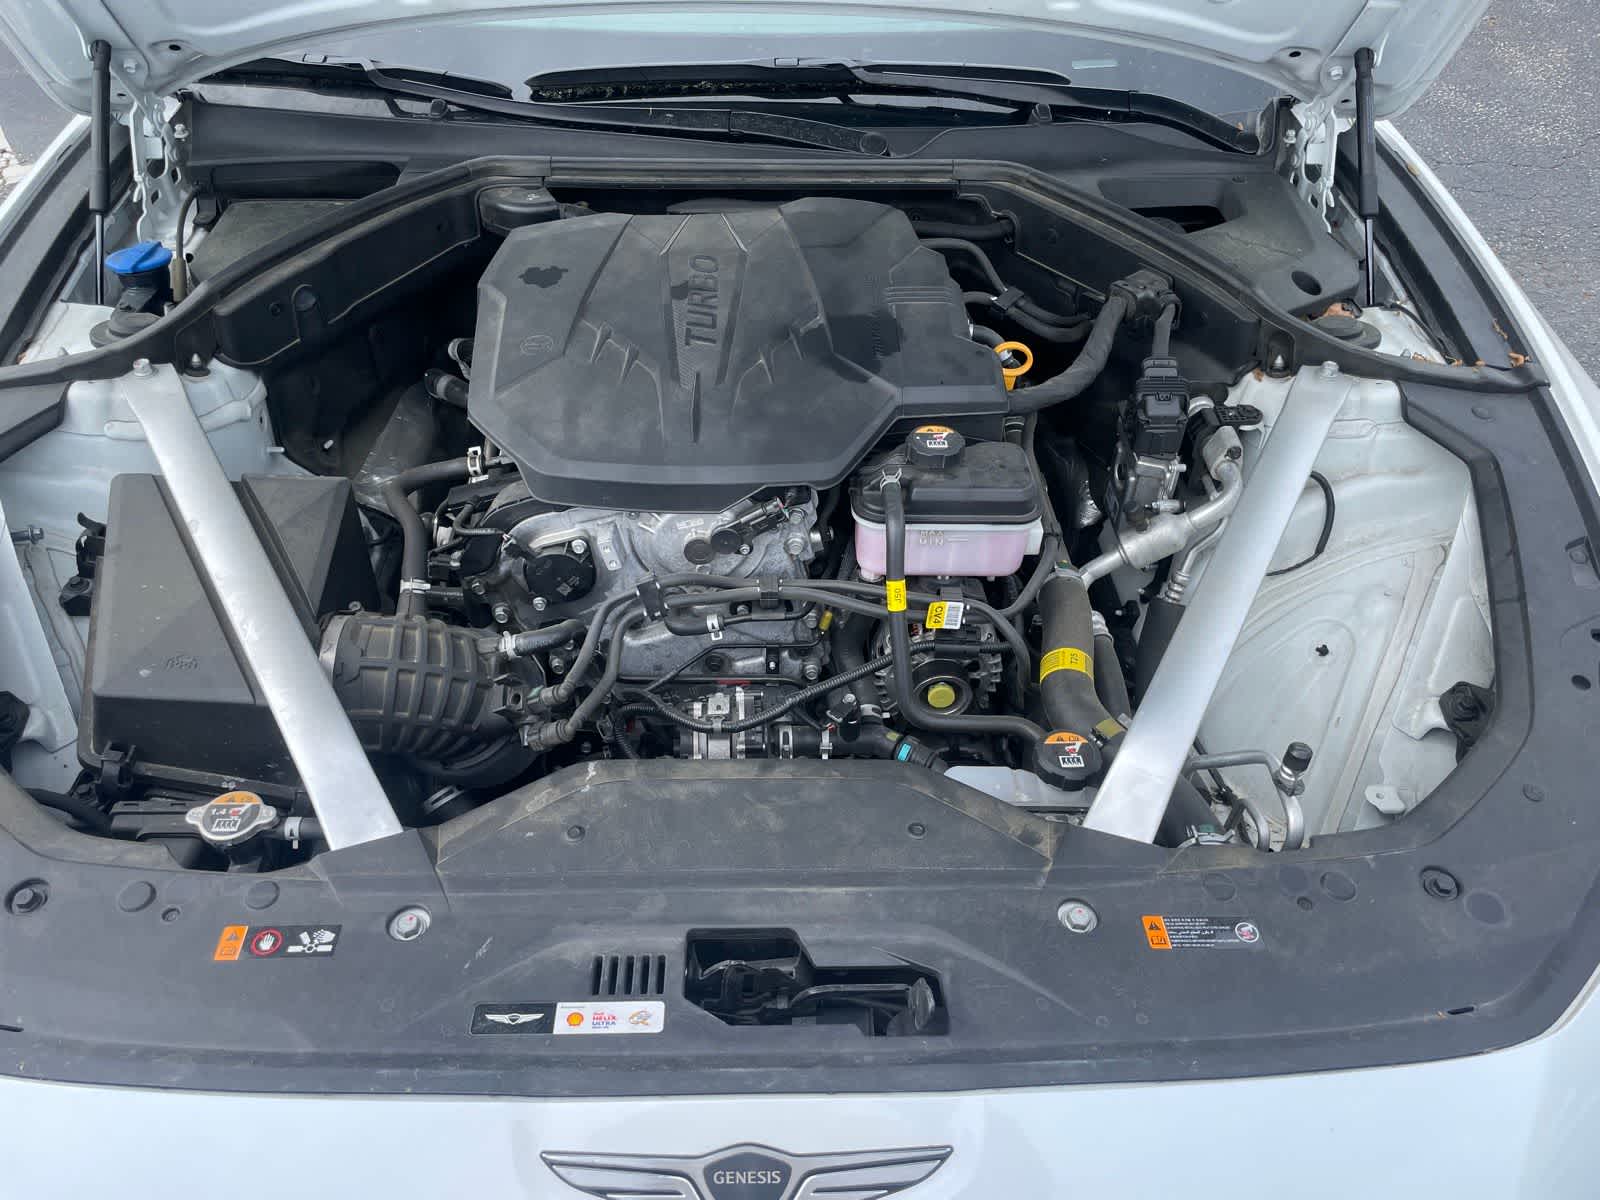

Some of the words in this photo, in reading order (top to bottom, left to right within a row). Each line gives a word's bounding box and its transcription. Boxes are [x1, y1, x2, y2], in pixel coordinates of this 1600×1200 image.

[684, 254, 719, 346] TURBO
[933, 606, 944, 624] CV4
[713, 1170, 782, 1184] GENESIS
